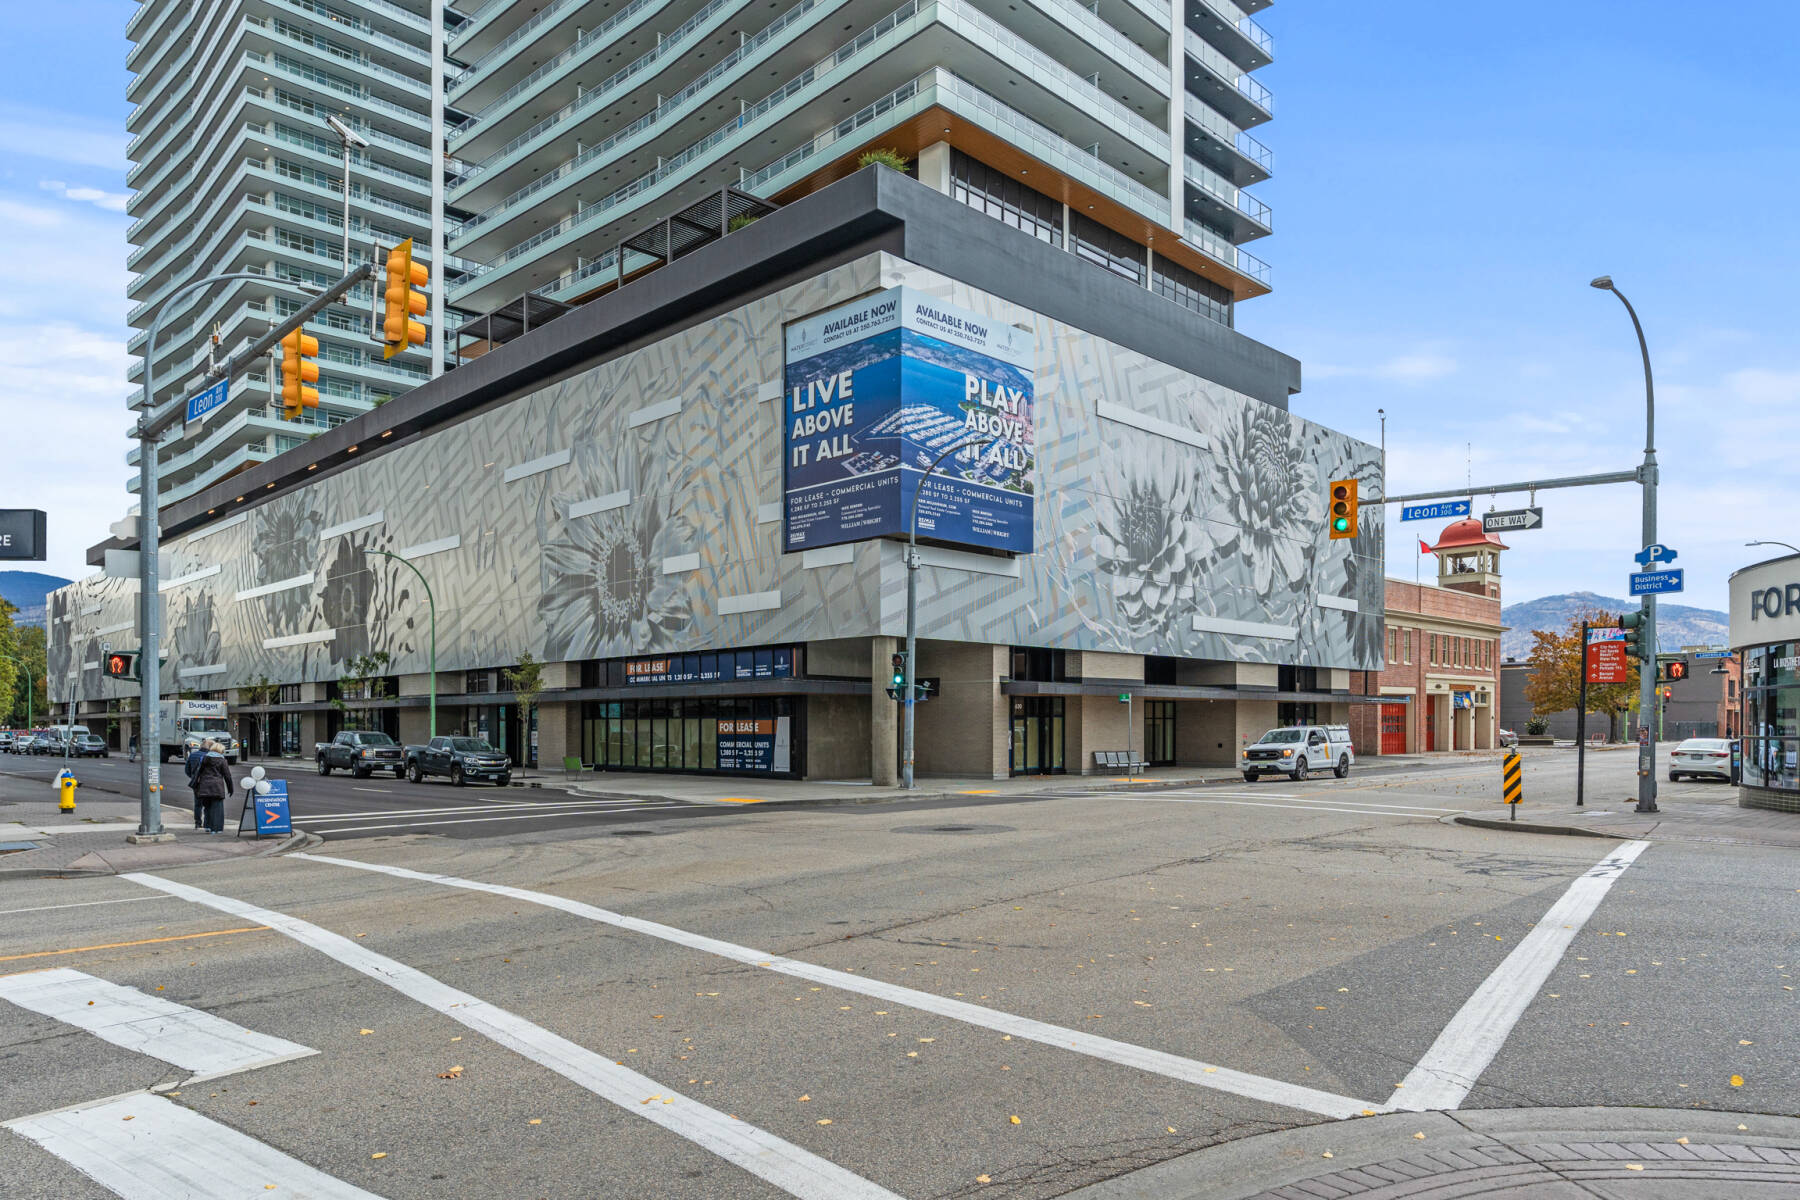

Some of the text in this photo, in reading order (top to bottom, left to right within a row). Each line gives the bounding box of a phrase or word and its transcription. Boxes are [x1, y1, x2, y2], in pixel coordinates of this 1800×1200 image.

[823, 300, 896, 336] AVAILABLE NOW
[916, 304, 988, 338] AVAILABLE NOW
[916, 317, 938, 330] CONTACT
[824, 332, 844, 344] CONTACT
[793, 370, 853, 412] LIVE
[965, 374, 1023, 415] PLAY
[194, 393, 212, 415] Leon
[792, 403, 853, 440] ABOVE
[964, 409, 1023, 444] ABOVE
[793, 434, 854, 468] IT ALL
[965, 438, 1024, 470] IT ALL
[790, 496, 802, 506] FOR
[804, 492, 824, 502] LEASE
[831, 481, 876, 496] COMMERCIAL
[878, 476, 899, 486] UNITS
[918, 479, 932, 488] FOR
[934, 482, 954, 492] LEASE
[962, 488, 1003, 503] COMMERCIAL
[1004, 497, 1022, 508] UNITS
[1408, 506, 1438, 518] Leon
[1488, 515, 1527, 527] ONE WAY
[1650, 546, 1662, 561] P
[1635, 574, 1668, 583] Business
[1635, 582, 1662, 590] District
[630, 662, 664, 673] FOR LEASE
[189, 702, 218, 710] Budget
[720, 722, 759, 732] FOR LEASE
